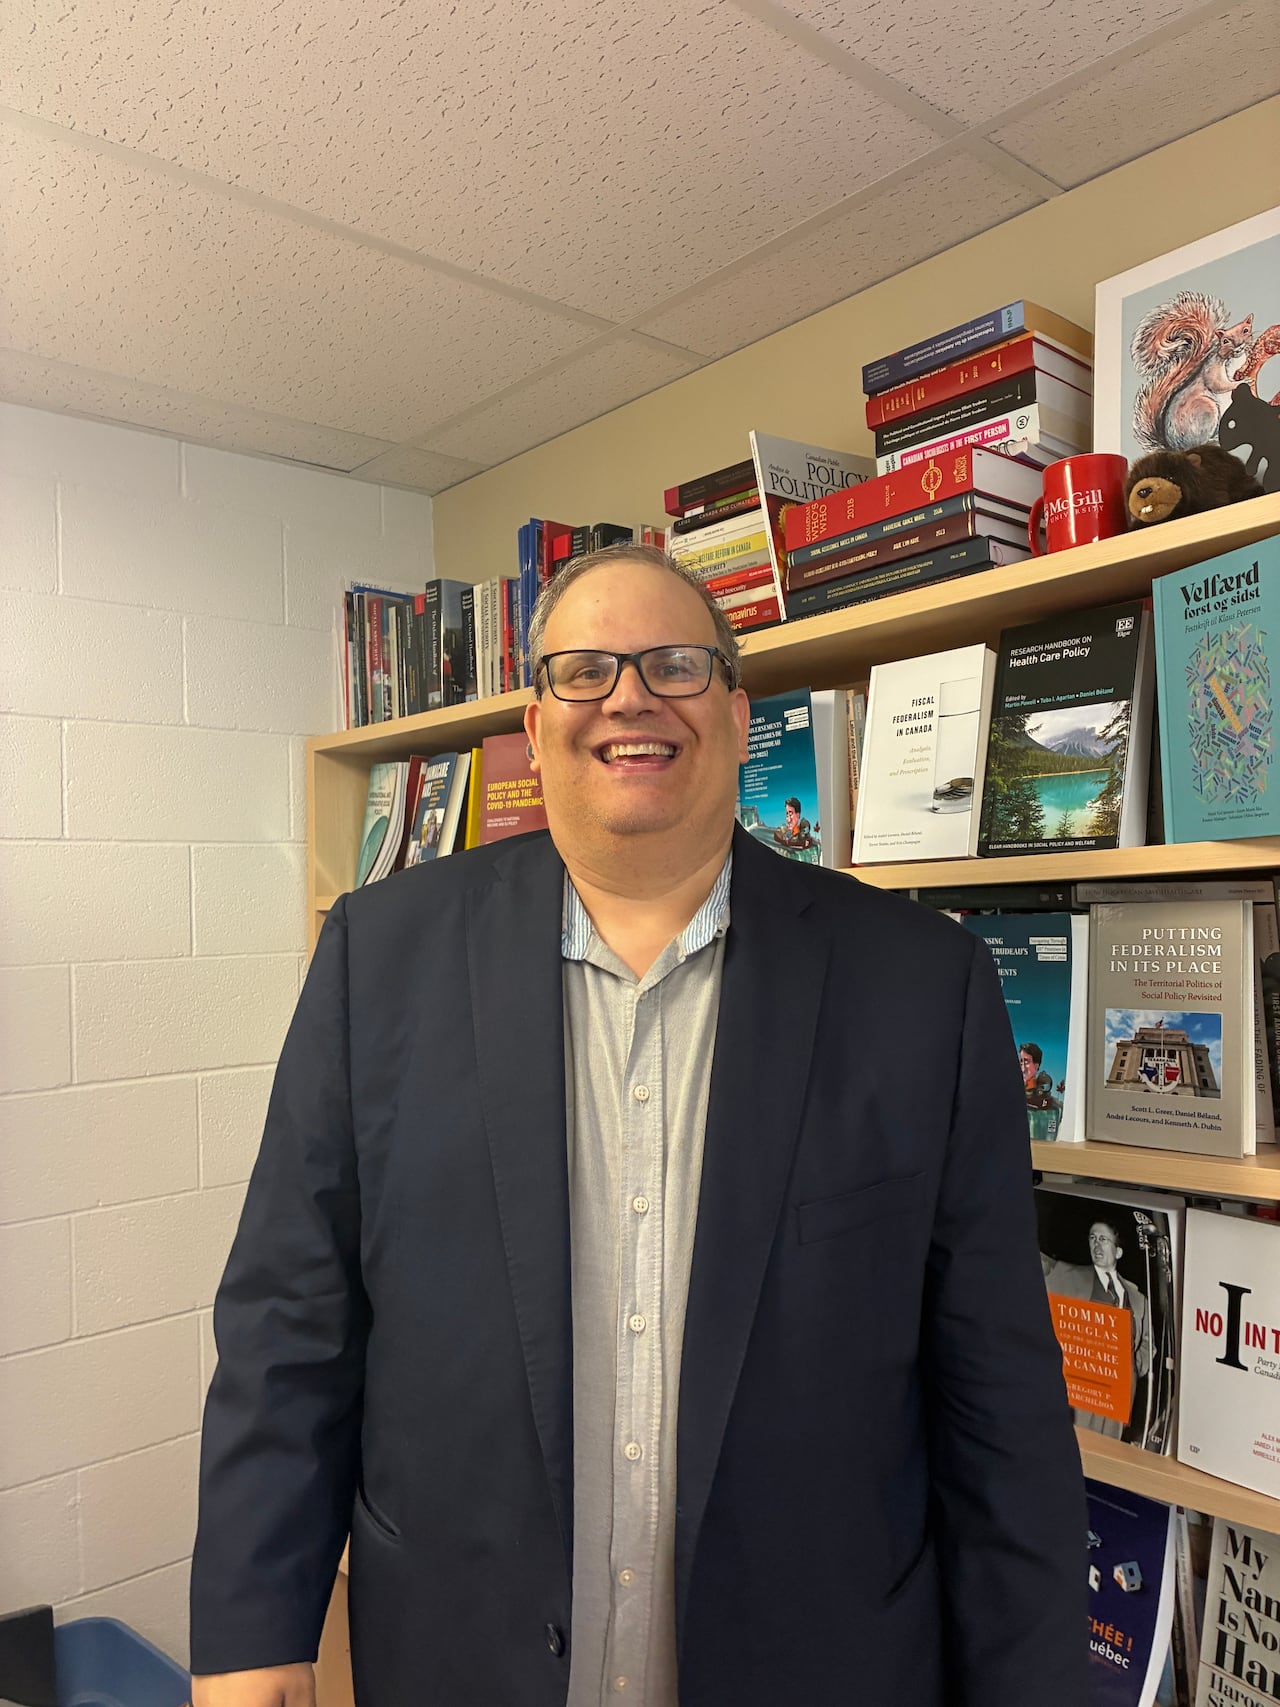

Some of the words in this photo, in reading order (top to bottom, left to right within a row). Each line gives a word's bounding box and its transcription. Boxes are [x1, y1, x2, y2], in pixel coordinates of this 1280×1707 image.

[902, 452, 924, 467] CANADIAN
[955, 439, 963, 448] THE
[964, 432, 983, 445] FIRST
[983, 423, 1007, 439] PERSON
[805, 453, 827, 464] Canadian
[827, 458, 840, 466] Public
[806, 462, 869, 488] POLICY
[698, 509, 719, 519] CANADA
[719, 505, 729, 513] AND
[730, 499, 751, 509] CLIMATE
[846, 497, 855, 520] 2018
[1049, 488, 1104, 517] McGill
[811, 502, 819, 542] WHO'S
[819, 504, 827, 534] WHO
[1050, 504, 1104, 524] UNIVRSITY
[715, 547, 731, 559] REFORM
[736, 541, 751, 553] CANADA
[725, 584, 747, 594] Insecurity
[1180, 560, 1260, 606] Velfærd
[1213, 597, 1229, 613] og
[1230, 586, 1261, 606] sidst
[1117, 618, 1133, 630] EE
[1184, 618, 1210, 634] Festskrift
[1218, 613, 1236, 624] Klaus
[1236, 606, 1262, 618] Petersen
[1010, 644, 1044, 657] RESEARCH
[1044, 637, 1081, 650] HANDBOOK
[1081, 635, 1093, 643] ON
[1009, 655, 1039, 668] Health
[1039, 650, 1061, 663] Care
[1062, 645, 1091, 659] Policy
[911, 696, 935, 708] FISCAL
[1005, 695, 1020, 703] Edited
[1056, 693, 1076, 702] Agartan
[1079, 690, 1096, 698] Daniel
[892, 710, 935, 724] FEDERALISM
[896, 728, 904, 737] IN
[905, 723, 933, 736] CANADA
[759, 739, 782, 749] TRUDEAU
[889, 769, 900, 777] and
[899, 767, 929, 777] Prescription
[487, 780, 517, 792] EUROPEAN
[518, 778, 539, 788] SOCIAL
[487, 791, 507, 801] POLICY
[507, 789, 520, 799] AND
[521, 788, 533, 797] THE
[487, 800, 512, 811] COVID-19
[512, 797, 544, 808] PANDEMIC
[1142, 927, 1222, 940] PUTTING
[991, 947, 1029, 956] TRUDEAU'S
[1111, 944, 1222, 957] FEDERALISM
[1110, 960, 1129, 972] IN
[1133, 960, 1160, 973] ITS
[1166, 961, 1222, 974] PLACE
[1134, 979, 1148, 987] The
[1149, 979, 1185, 988] Territorial
[1186, 980, 1213, 989] Politics
[1214, 980, 1222, 989] of
[1141, 991, 1163, 1000] Social
[1164, 992, 1187, 1002] Policy
[1188, 993, 1222, 1001] Revisited
[1131, 1105, 1148, 1113] Scott
[1155, 1108, 1174, 1117] Greer,
[1175, 1110, 1196, 1118] Daniel
[1197, 1111, 1222, 1121] Béland,
[1106, 1112, 1124, 1121] André
[1125, 1114, 1151, 1123] Lecours,
[1151, 1116, 1164, 1125] and
[1164, 1119, 1192, 1128] Kenneth
[1201, 1123, 1222, 1131] Dubin
[1057, 1303, 1118, 1328] TOMMY
[1059, 1319, 1119, 1341] DOUGLAS
[1195, 1307, 1224, 1338] NO
[1215, 1281, 1252, 1372] I
[1244, 1321, 1267, 1351] IN
[1060, 1342, 1119, 1365] MEDICARE
[1073, 1360, 1119, 1379] CANADA
[1256, 1355, 1278, 1371] Party
[1254, 1440, 1272, 1450] JARED
[1261, 1432, 1275, 1442] ALEX
[1223, 1525, 1269, 1580] My
[1216, 1596, 1240, 1632] Is
[1241, 1609, 1280, 1652] No
[1089, 1639, 1131, 1670] uébec
